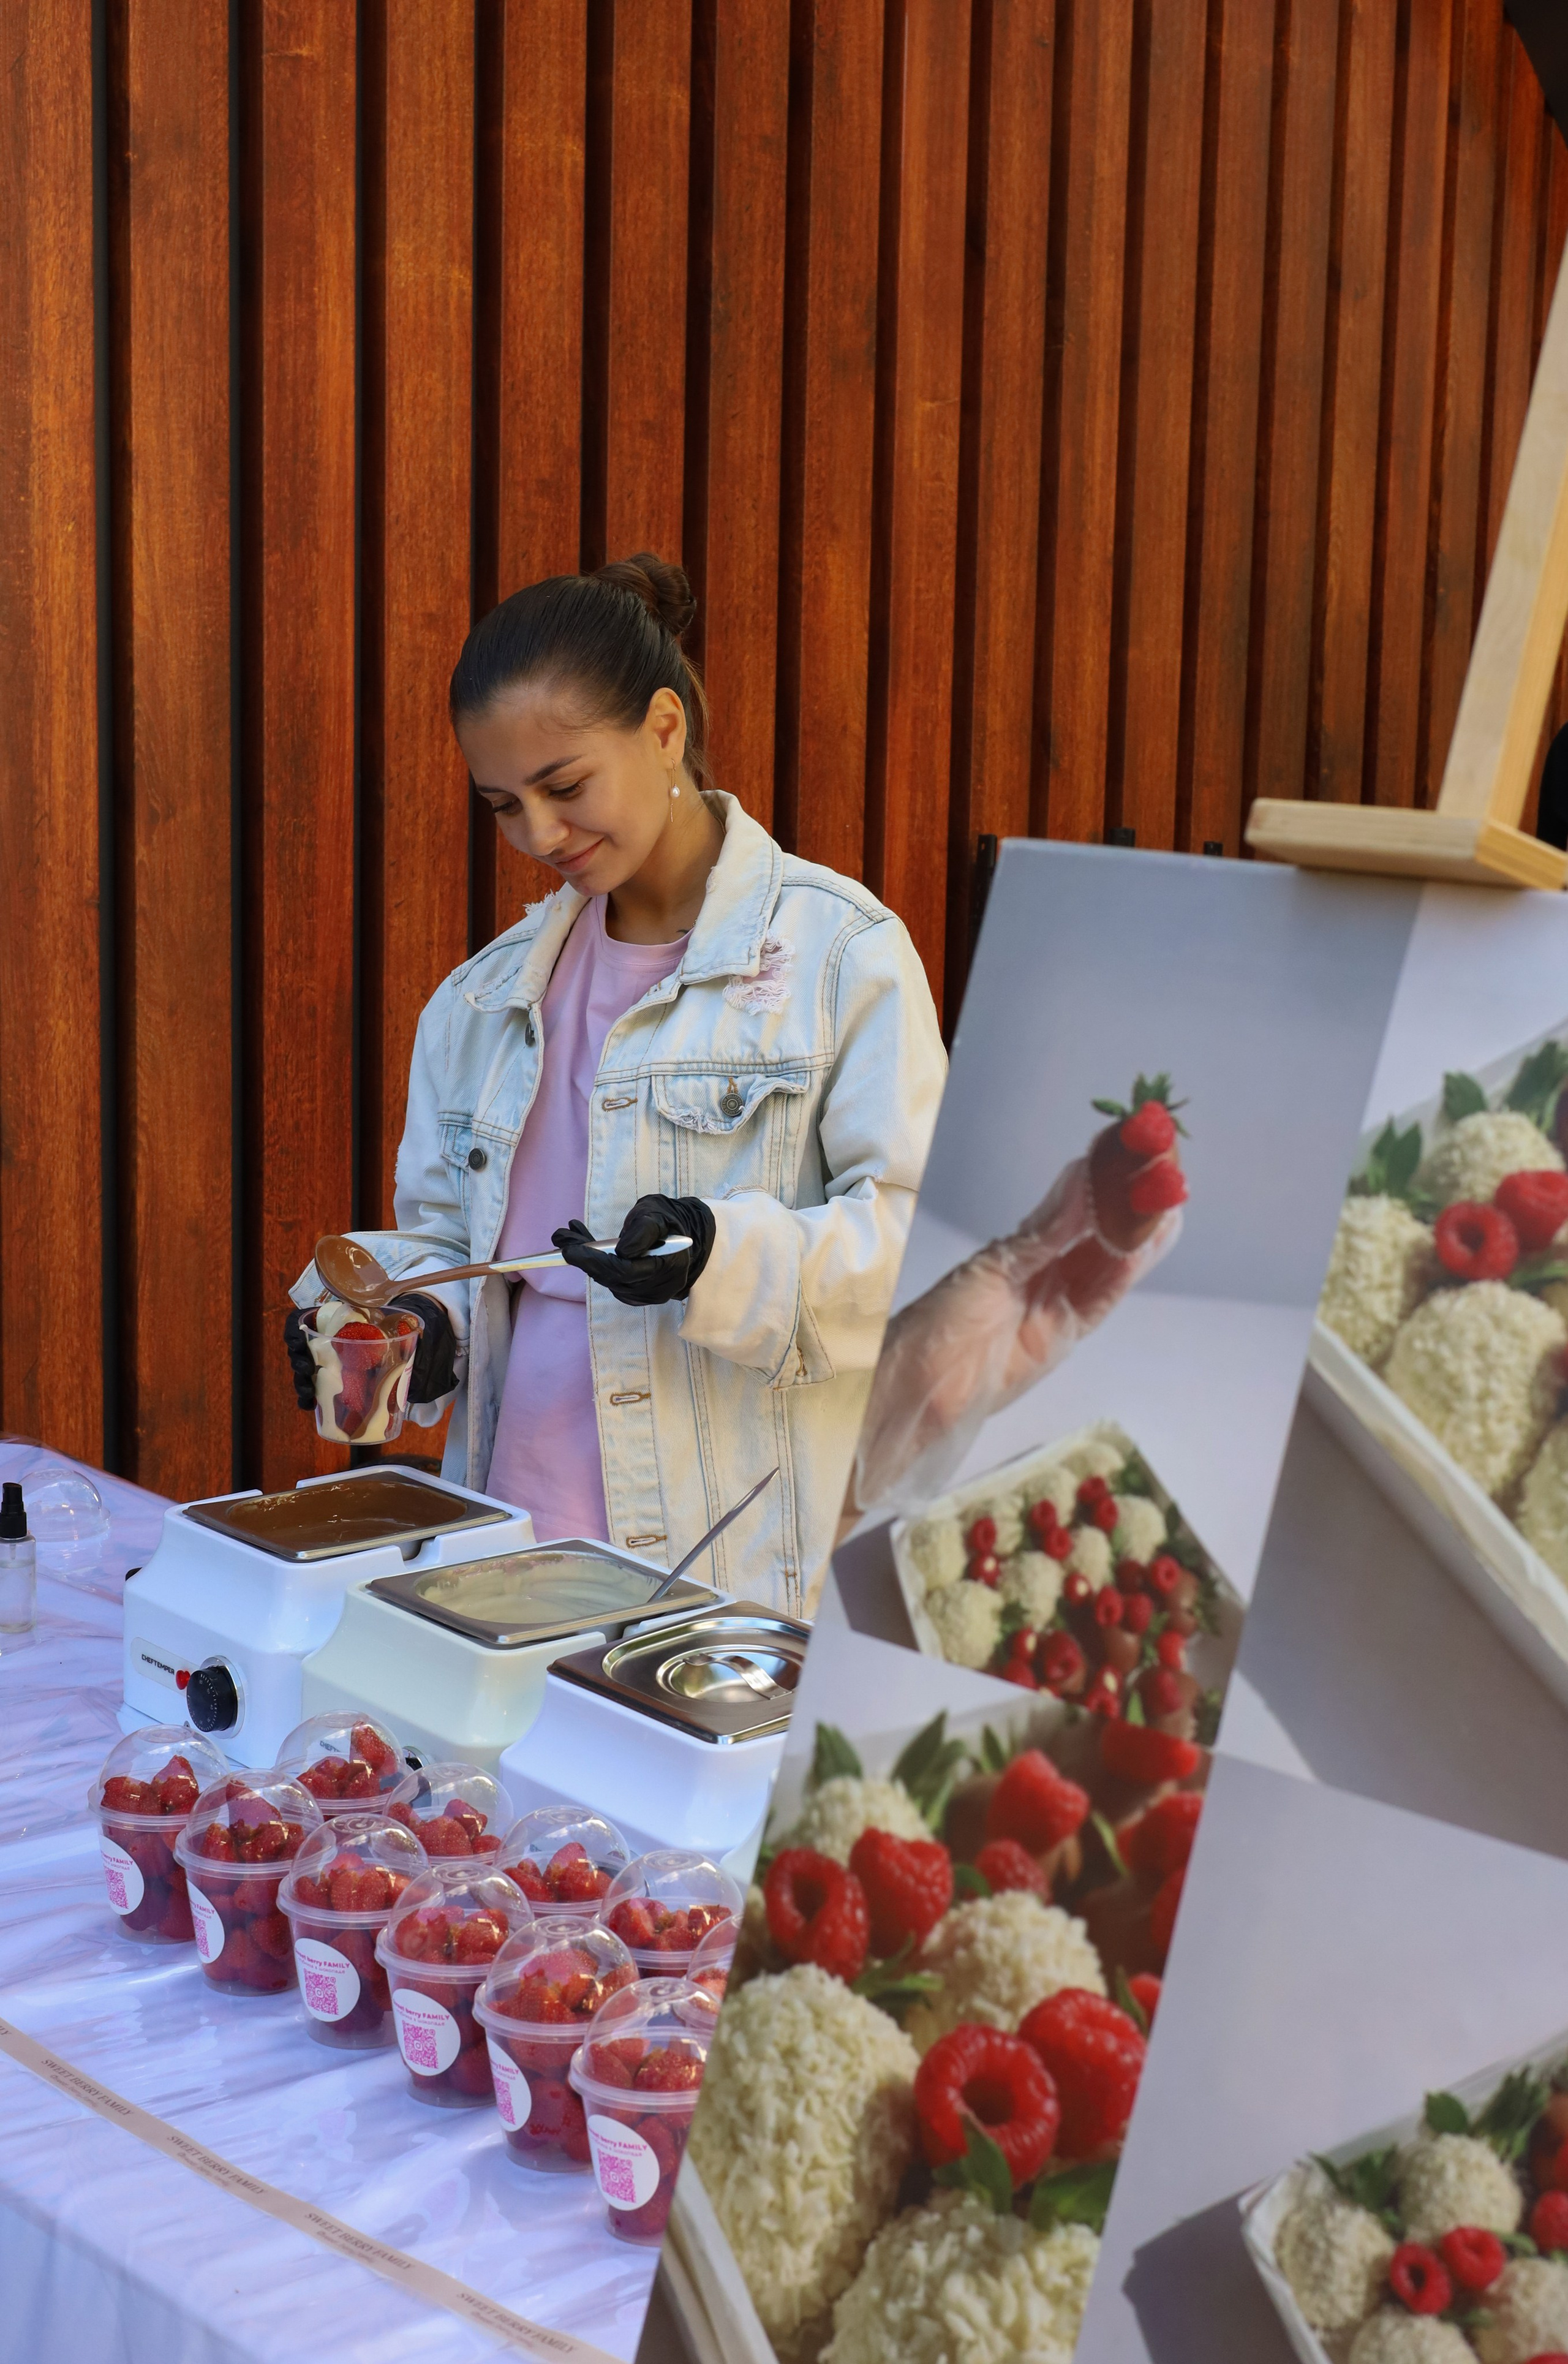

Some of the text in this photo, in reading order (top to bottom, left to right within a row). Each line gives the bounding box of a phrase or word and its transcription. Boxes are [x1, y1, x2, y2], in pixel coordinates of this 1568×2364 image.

[141, 1654, 175, 1675] CHEFTEMPER
[307, 1955, 322, 1966] berry
[405, 2007, 421, 2018] berry
[41, 2059, 75, 2078] SWEET
[70, 2077, 103, 2096] BERRY
[97, 2095, 134, 2115] FAMILY
[618, 2142, 647, 2151] FAMILY
[167, 2136, 203, 2156] SWEET
[198, 2156, 233, 2175] BERRY
[228, 2174, 266, 2194] FAMILY
[304, 2213, 343, 2234] SWEET
[339, 2233, 375, 2252] BERRY
